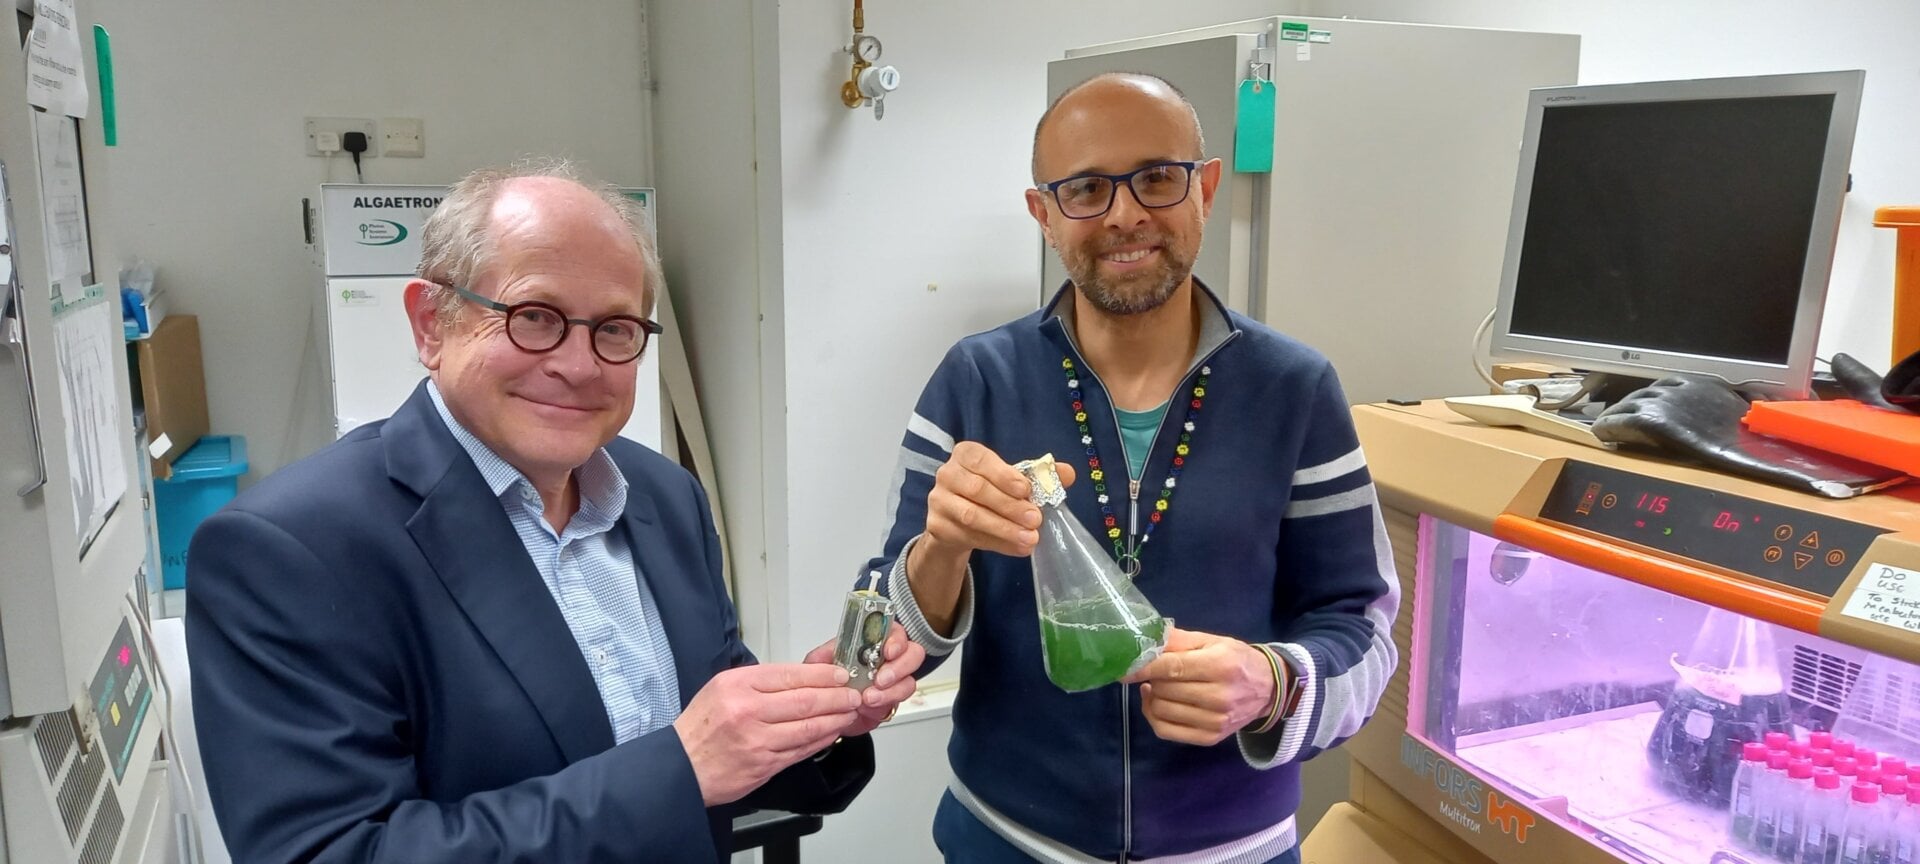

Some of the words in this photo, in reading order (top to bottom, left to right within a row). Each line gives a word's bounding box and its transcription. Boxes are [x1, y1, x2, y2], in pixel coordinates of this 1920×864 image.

[353, 197, 443, 208] ALGAETRON
[1636, 492, 1670, 514] 115
[1402, 735, 1482, 814] INFORS
[1487, 791, 1536, 844] HT
[1440, 801, 1481, 834] Multitron
